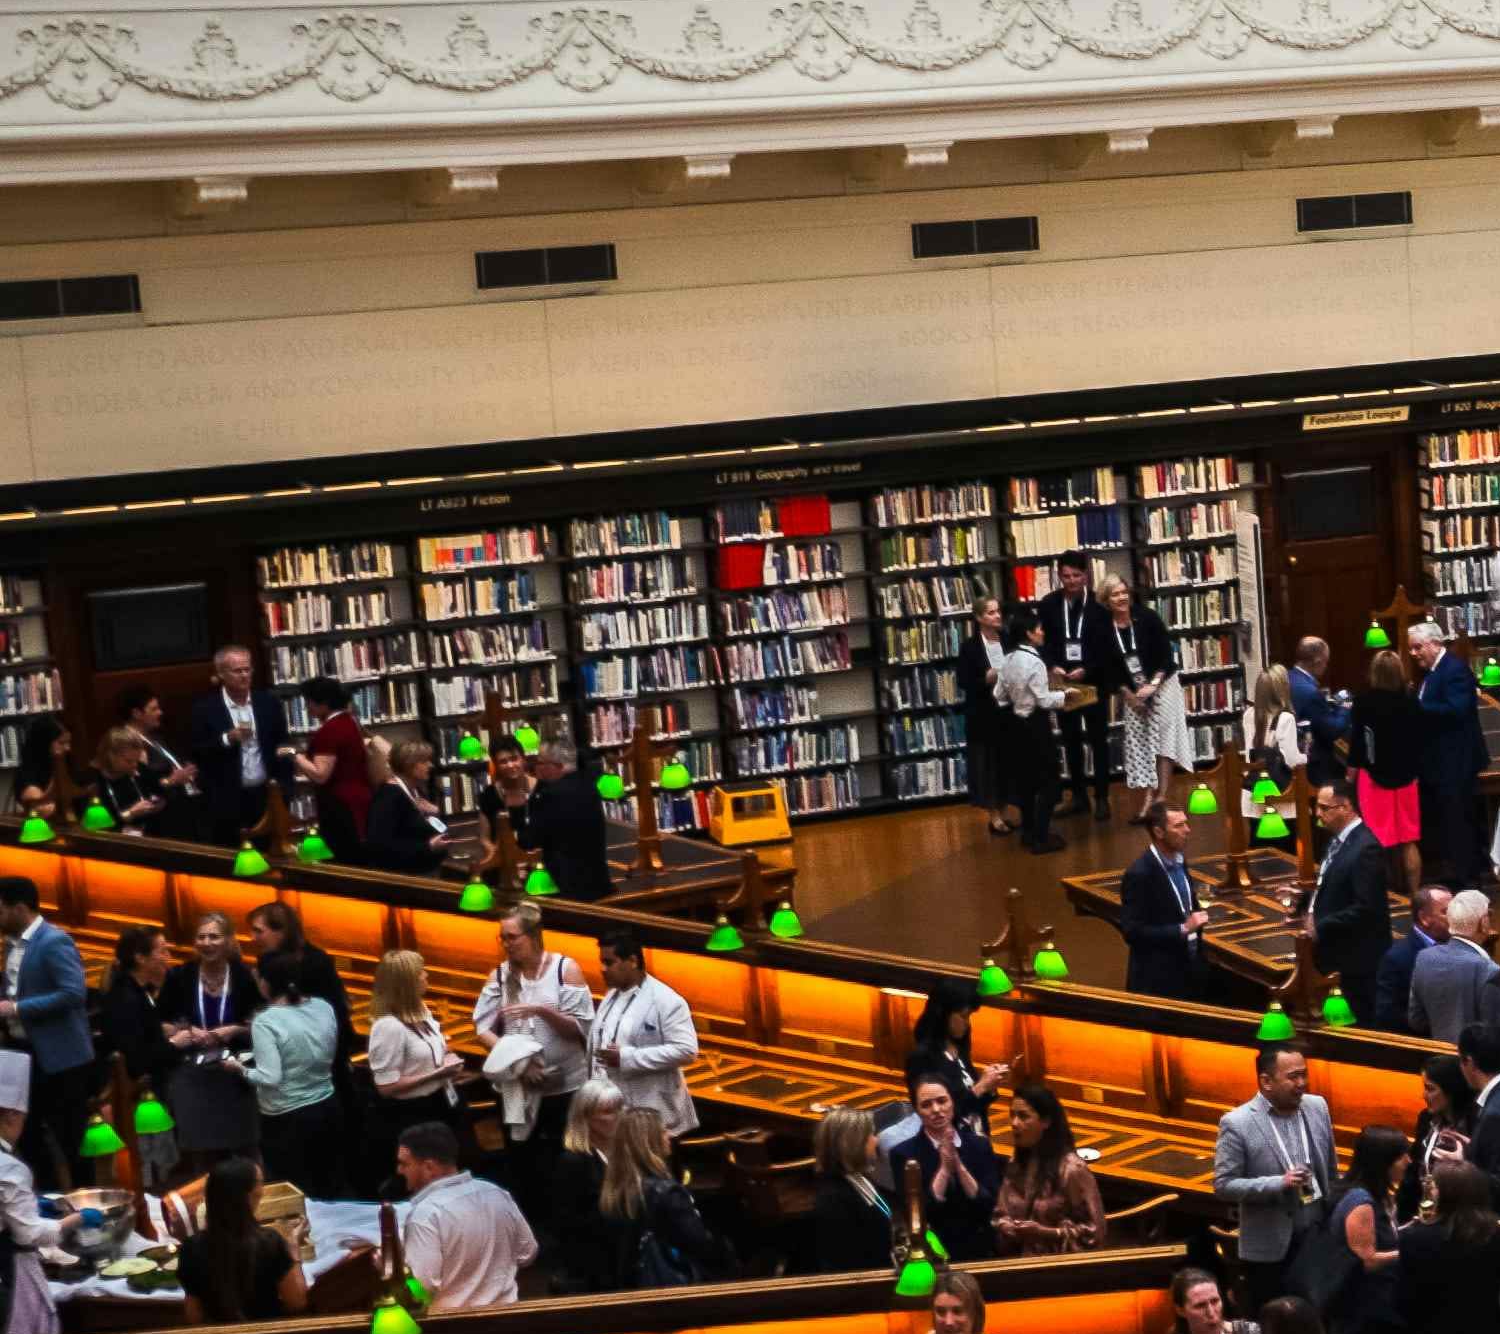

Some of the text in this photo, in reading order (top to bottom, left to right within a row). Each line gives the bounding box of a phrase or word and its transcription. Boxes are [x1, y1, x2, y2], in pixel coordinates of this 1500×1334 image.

[1311, 409, 1402, 425] Foundation Lounge
[756, 466, 808, 481] Geography
[813, 465, 831, 475] and
[833, 462, 861, 474] travel
[472, 493, 511, 506] Fiction
